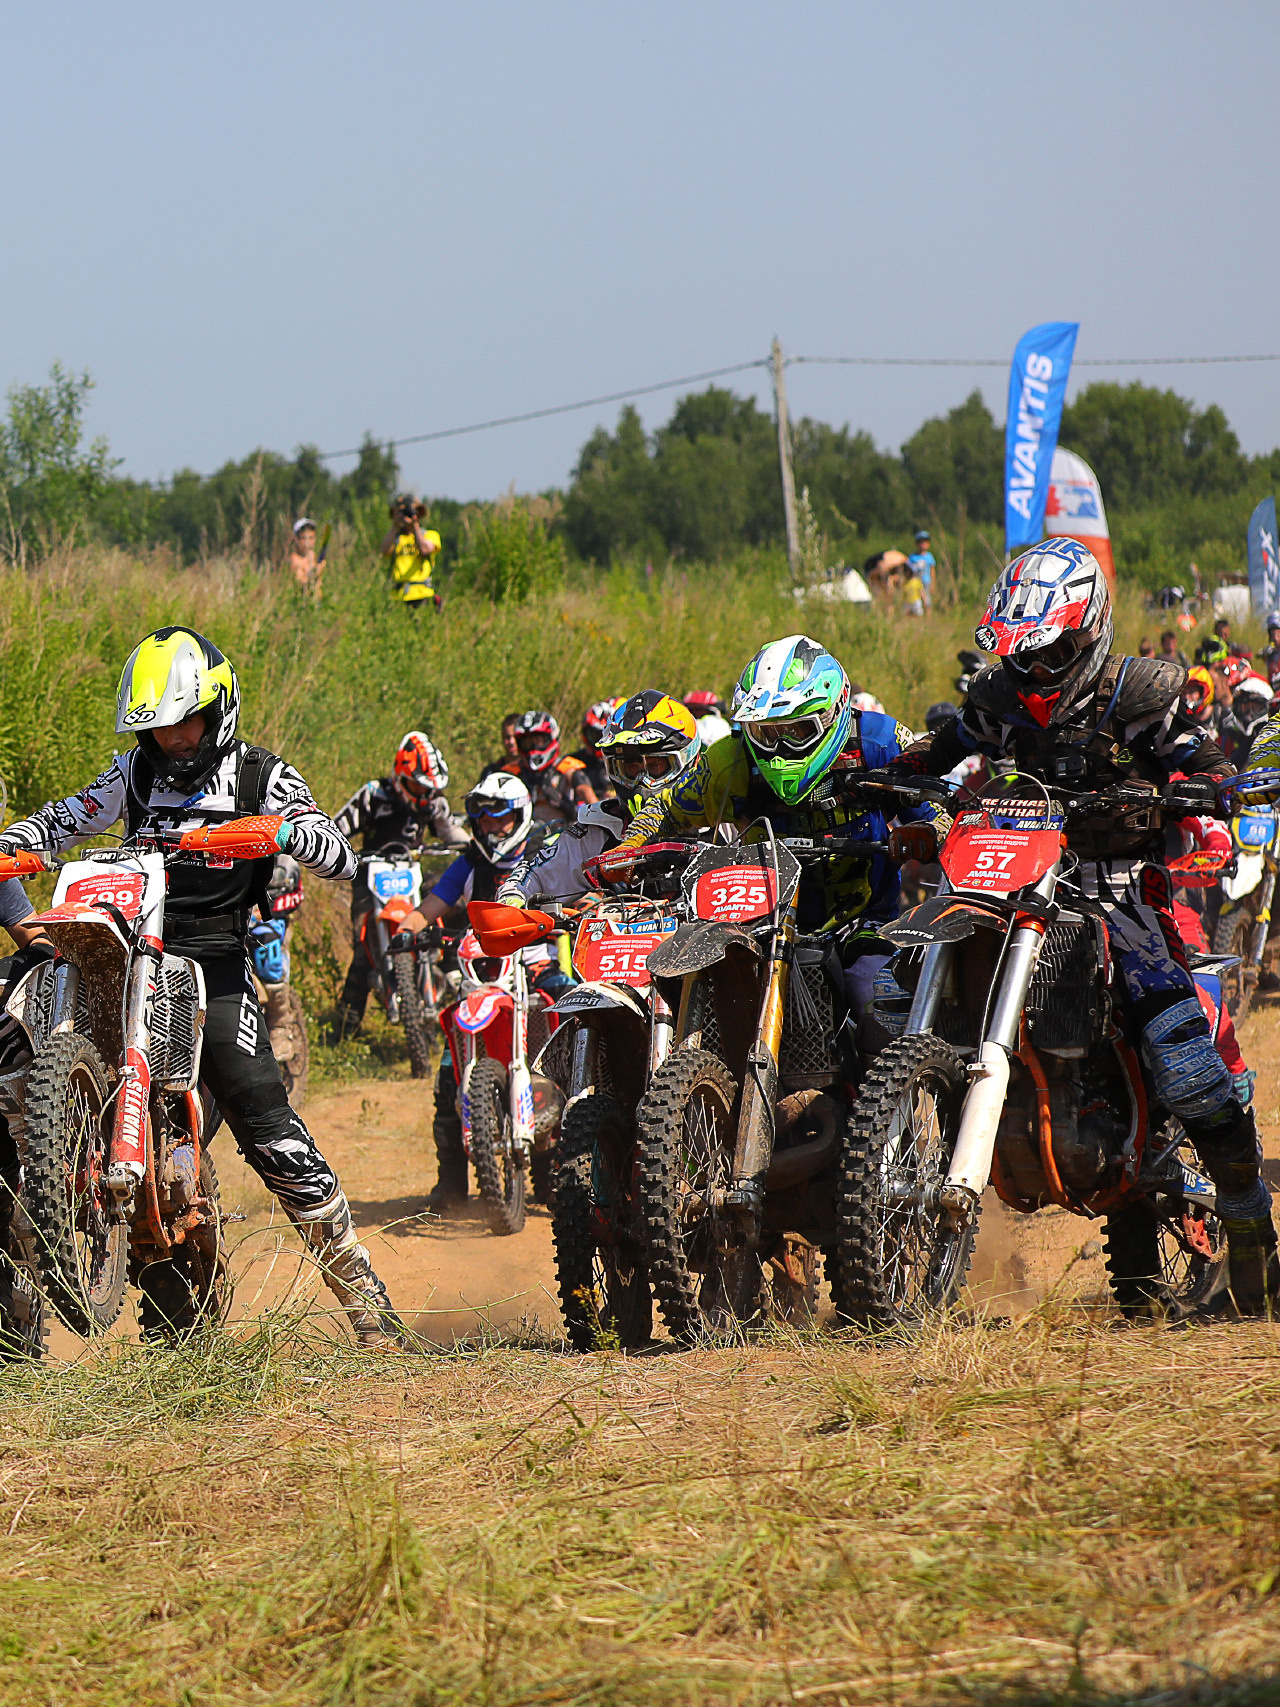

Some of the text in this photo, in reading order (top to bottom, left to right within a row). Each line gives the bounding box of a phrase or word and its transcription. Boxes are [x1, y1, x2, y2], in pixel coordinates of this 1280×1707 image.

[1008, 352, 1053, 520] AVANTIS
[976, 627, 995, 651] Airoh
[123, 703, 156, 727] 6D
[974, 851, 1017, 871] 57
[966, 871, 1011, 879] AVANTIS
[710, 886, 767, 906] 325
[713, 904, 756, 914] AVANTIS
[636, 920, 673, 932] AVANIS
[889, 929, 935, 940] AVANTIS
[599, 954, 649, 971] 515
[122, 1078, 144, 1150] AVANTIS
